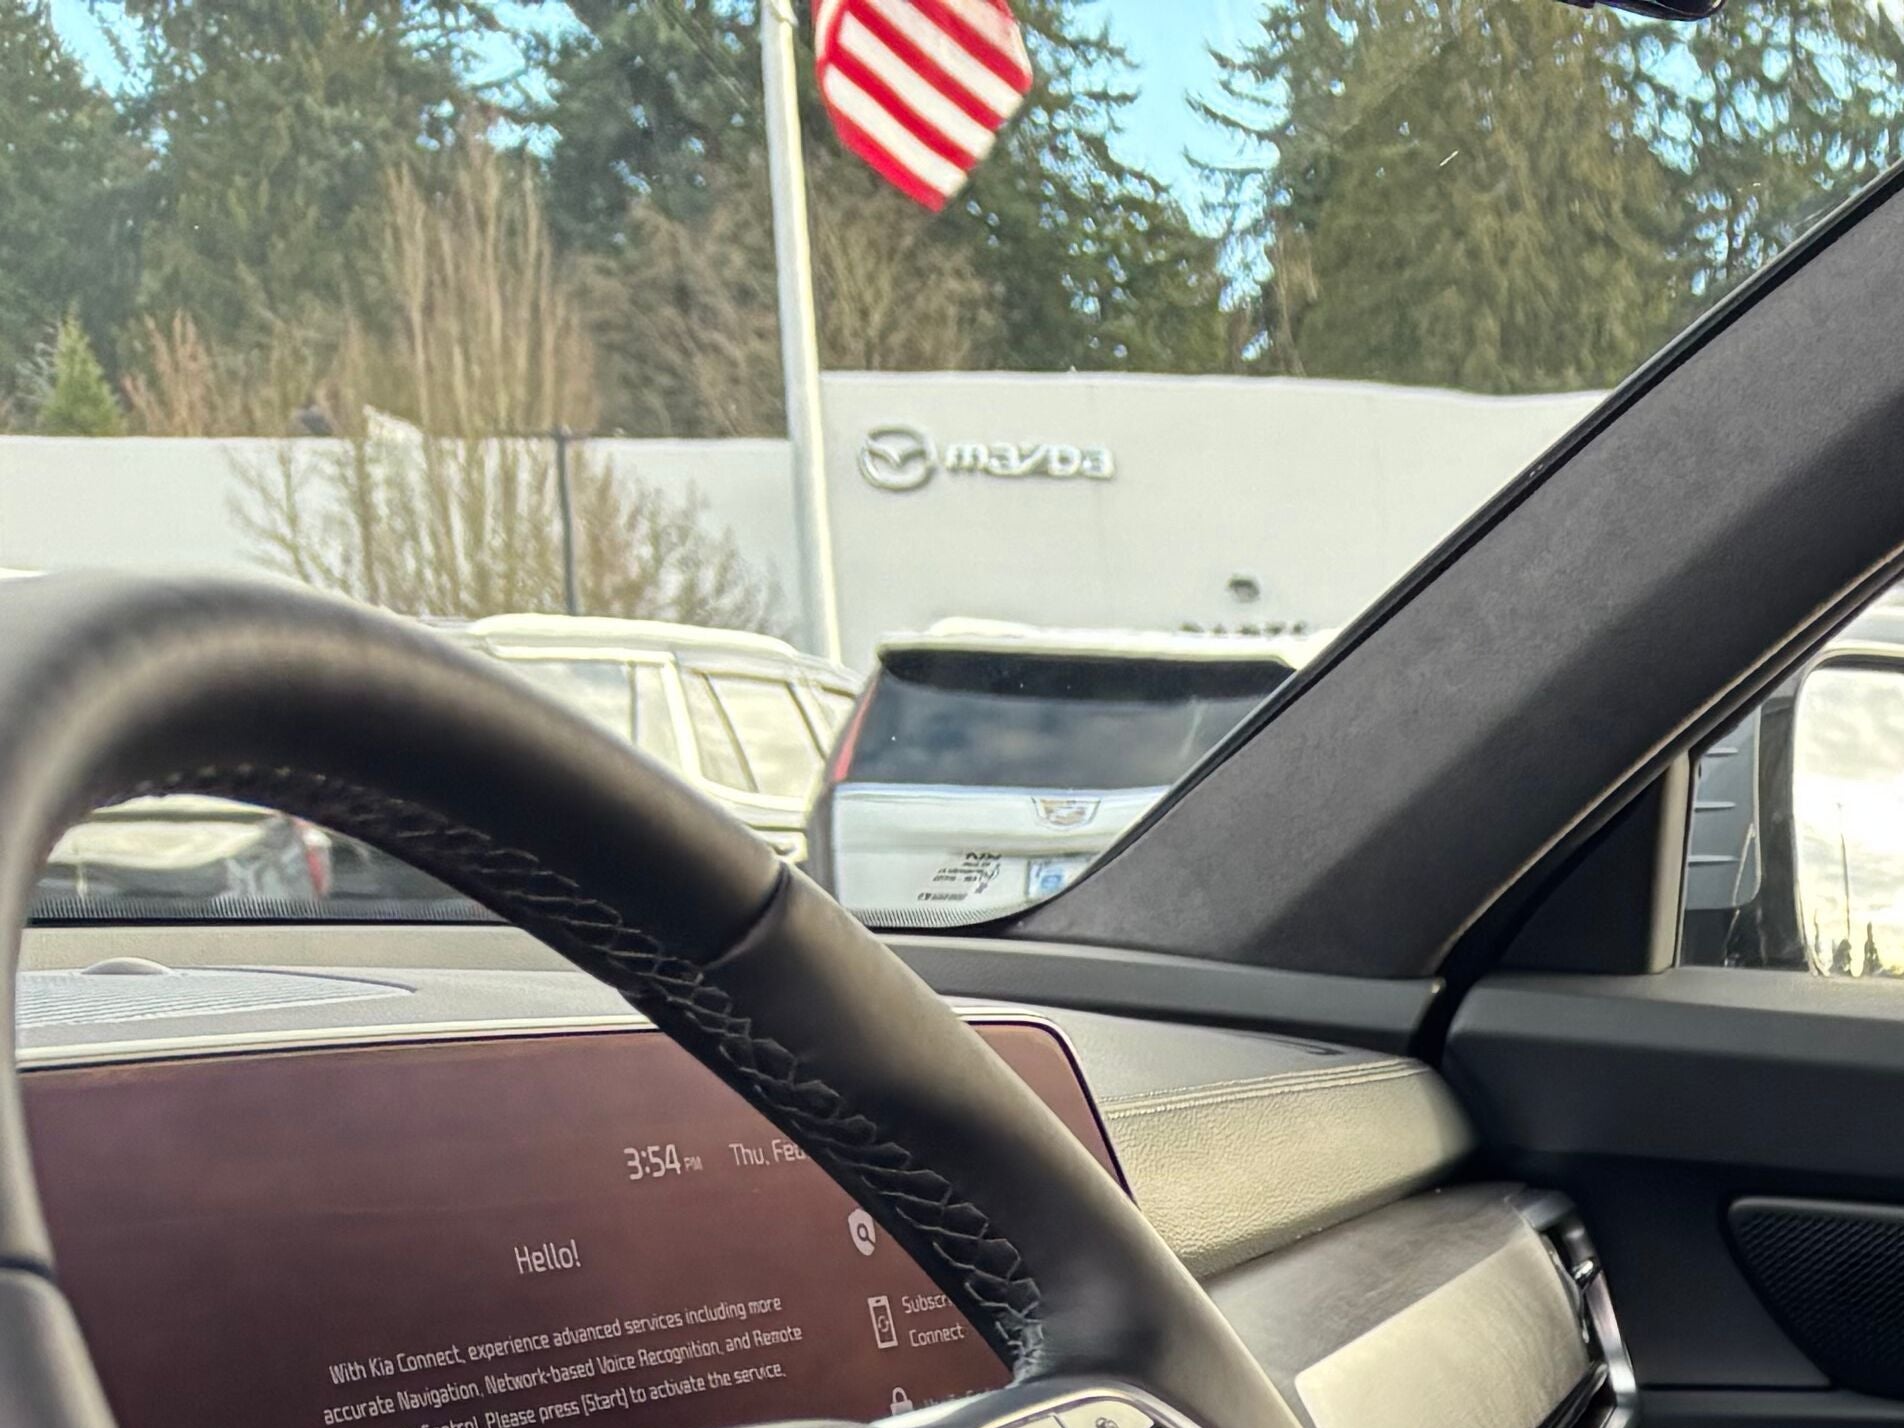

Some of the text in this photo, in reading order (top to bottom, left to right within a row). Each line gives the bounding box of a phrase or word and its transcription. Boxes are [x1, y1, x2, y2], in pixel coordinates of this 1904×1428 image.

[943, 441, 1115, 481] mazda
[623, 1144, 682, 1181] 3:54
[684, 1156, 704, 1172] PM
[514, 1239, 582, 1275] Hello!
[902, 1293, 953, 1314] Subscr
[329, 1362, 367, 1384] With
[368, 1357, 395, 1378] Kia
[468, 1332, 550, 1362] experience
[553, 1319, 622, 1349] advanced
[624, 1312, 683, 1336] services
[685, 1301, 747, 1325] including
[748, 1297, 782, 1315] more
[909, 1322, 965, 1348] Connect
[324, 1396, 395, 1425] accurate
[484, 1358, 595, 1395] Network-based
[597, 1354, 636, 1377] Voice
[726, 1331, 751, 1353] and
[753, 1325, 803, 1348] Remote
[539, 1399, 580, 1424] press
[581, 1386, 629, 1417] [Start]
[630, 1385, 647, 1404] to
[649, 1374, 707, 1400] activate
[707, 1371, 732, 1389] the
[733, 1363, 786, 1386] service.
